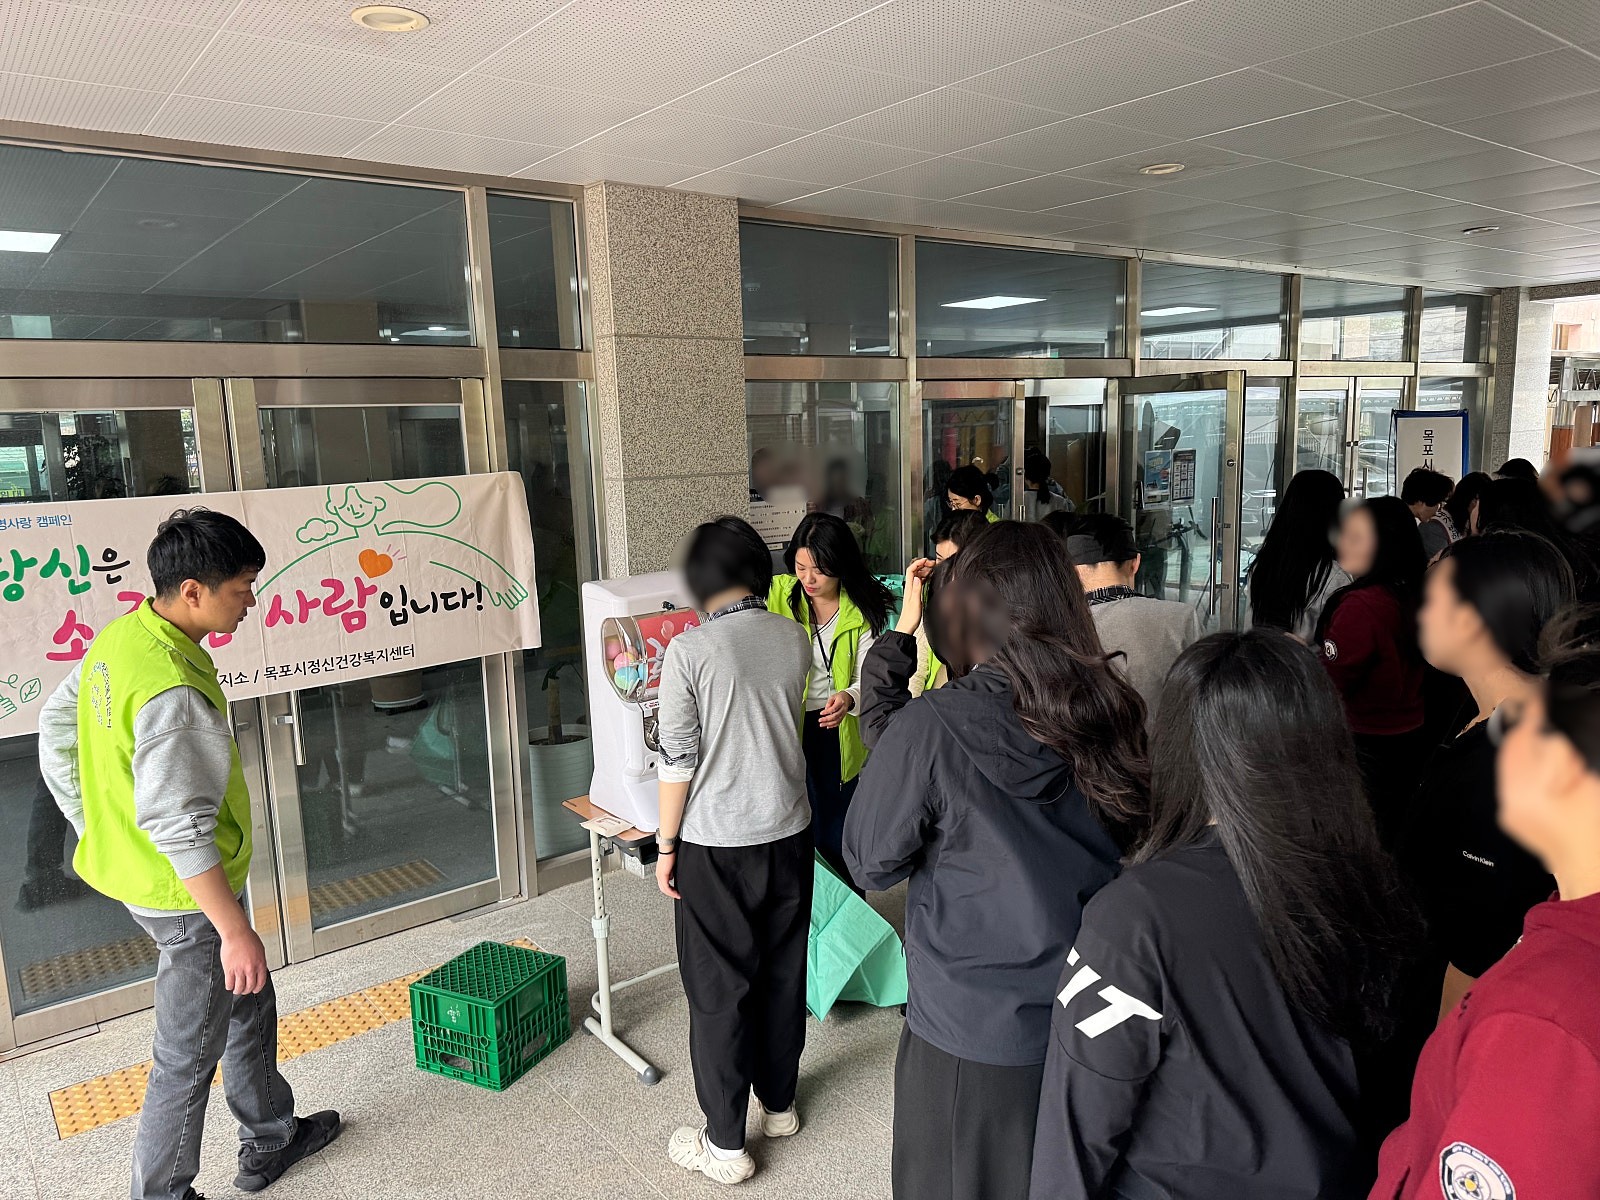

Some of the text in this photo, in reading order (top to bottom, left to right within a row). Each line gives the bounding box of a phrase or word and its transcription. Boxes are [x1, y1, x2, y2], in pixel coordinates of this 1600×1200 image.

[36, 514, 73, 528] 캠페인
[0, 545, 131, 602] 당신은
[265, 576, 483, 634] 사람입니다!
[263, 643, 416, 682] 목포시정신건강복지센터
[1462, 850, 1495, 868] Calvin Klein
